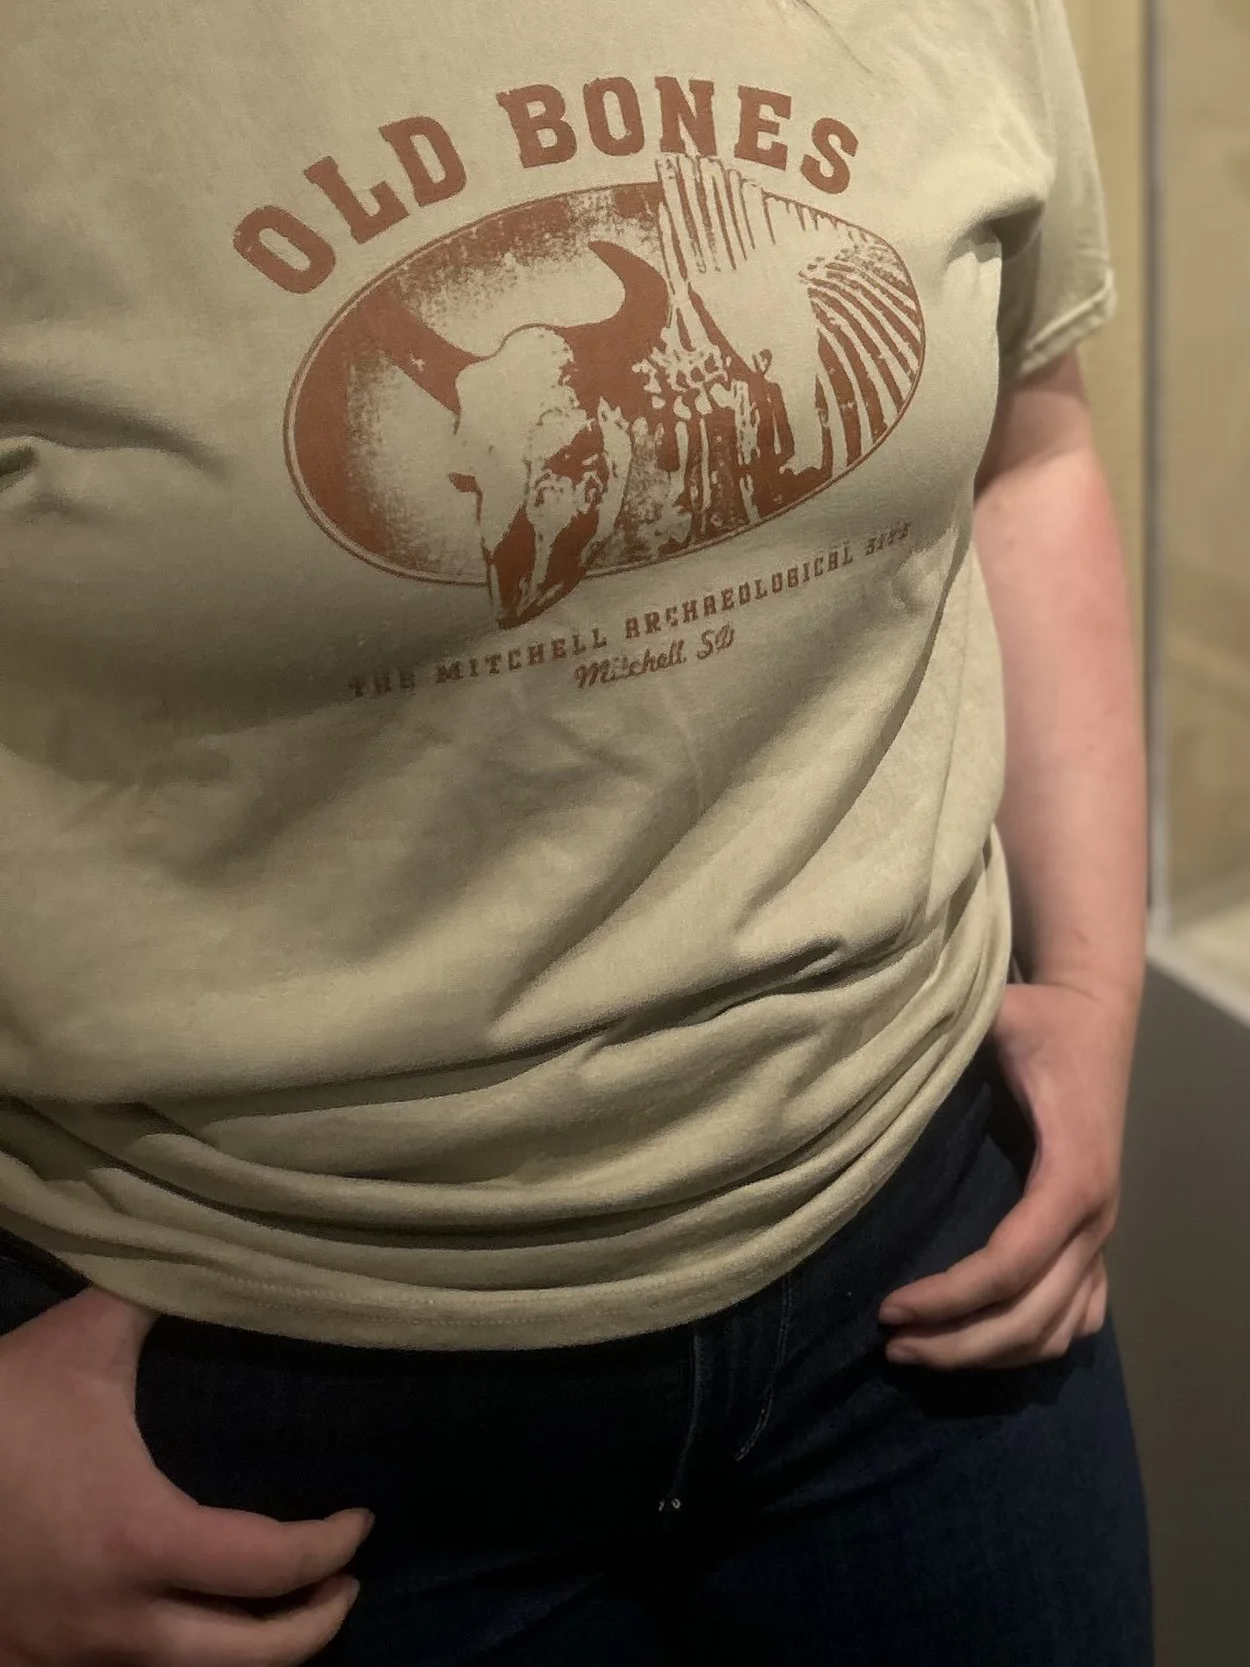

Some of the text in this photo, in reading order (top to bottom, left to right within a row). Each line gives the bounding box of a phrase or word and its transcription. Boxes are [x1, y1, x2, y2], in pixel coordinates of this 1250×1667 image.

[232, 76, 860, 294] OLD BONES
[350, 665, 416, 697] THE
[436, 628, 607, 684] MITCHELL
[625, 545, 853, 639] ARCHAEOLOGICAL
